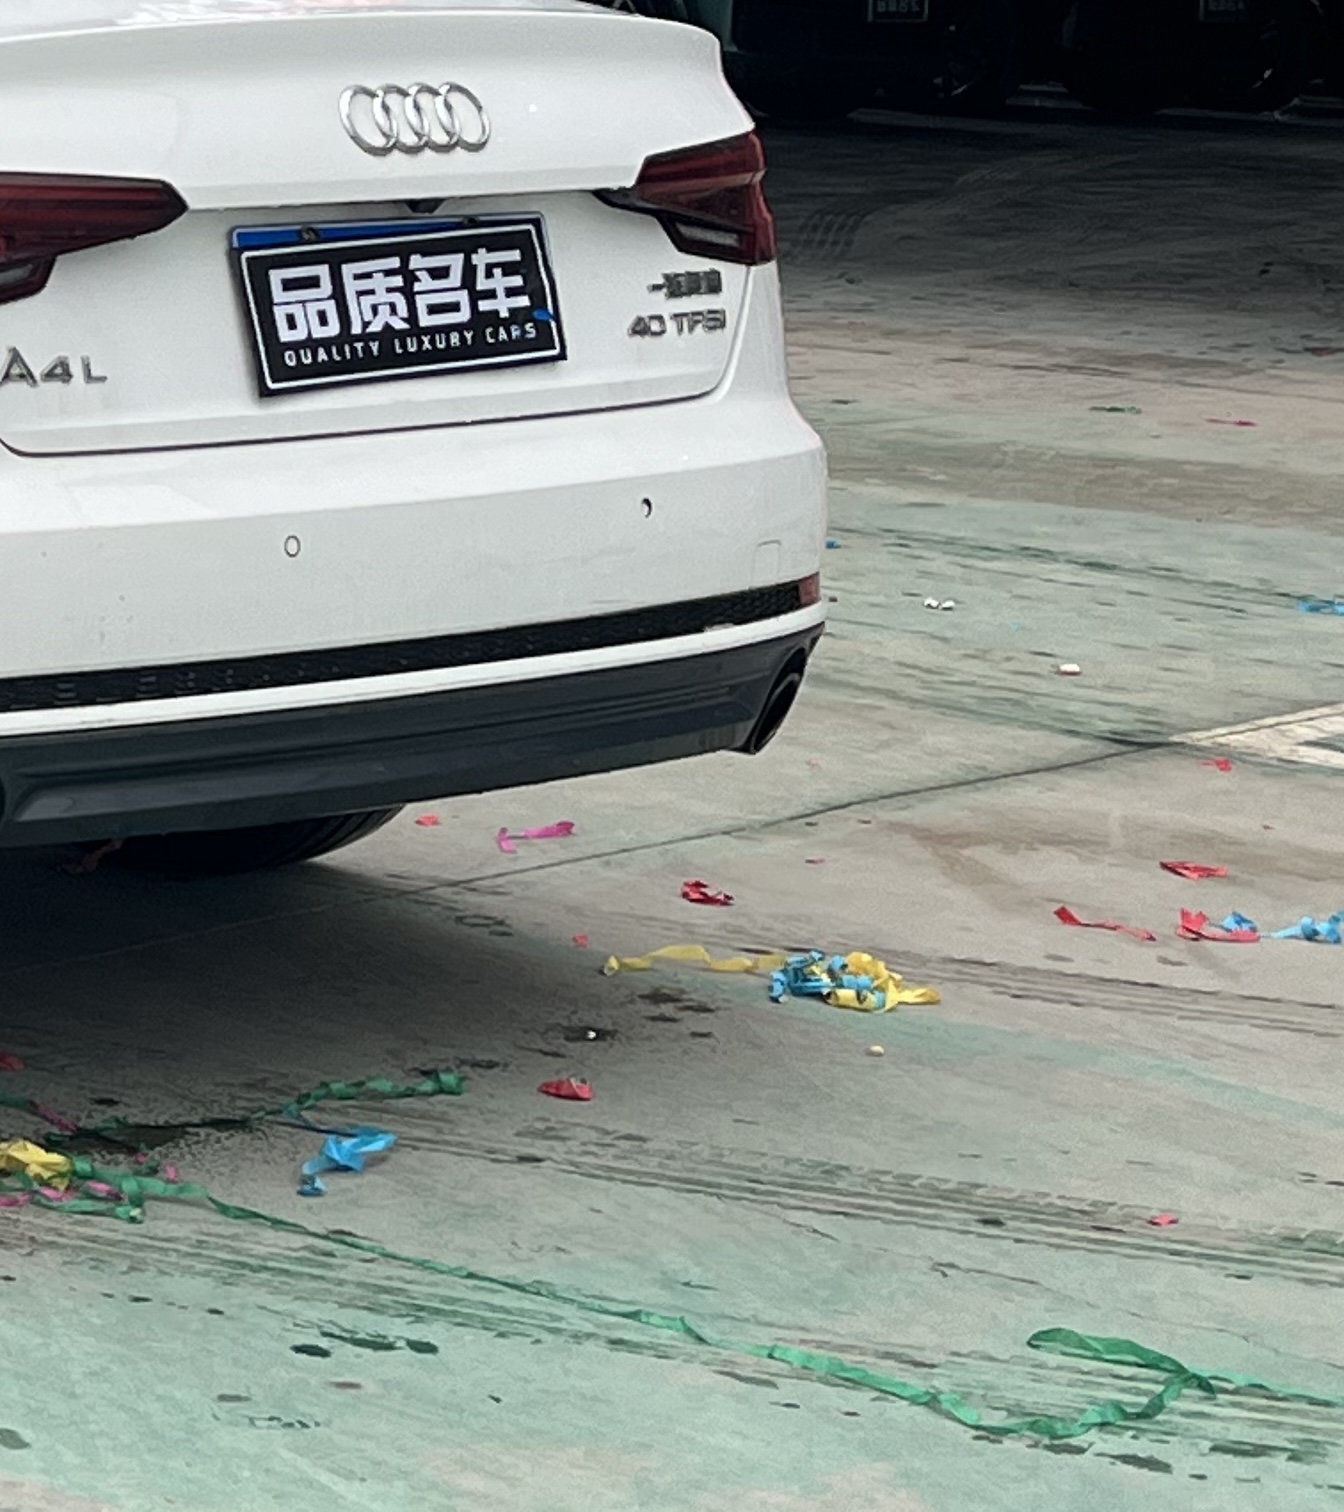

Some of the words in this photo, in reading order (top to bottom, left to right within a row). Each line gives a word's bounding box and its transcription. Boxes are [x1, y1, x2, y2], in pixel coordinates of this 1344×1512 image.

[267, 247, 532, 344] 品质名车
[283, 340, 380, 368] QUALITY
[394, 329, 475, 355] LUXURY
[485, 321, 538, 345] CARS
[627, 313, 667, 339] 40
